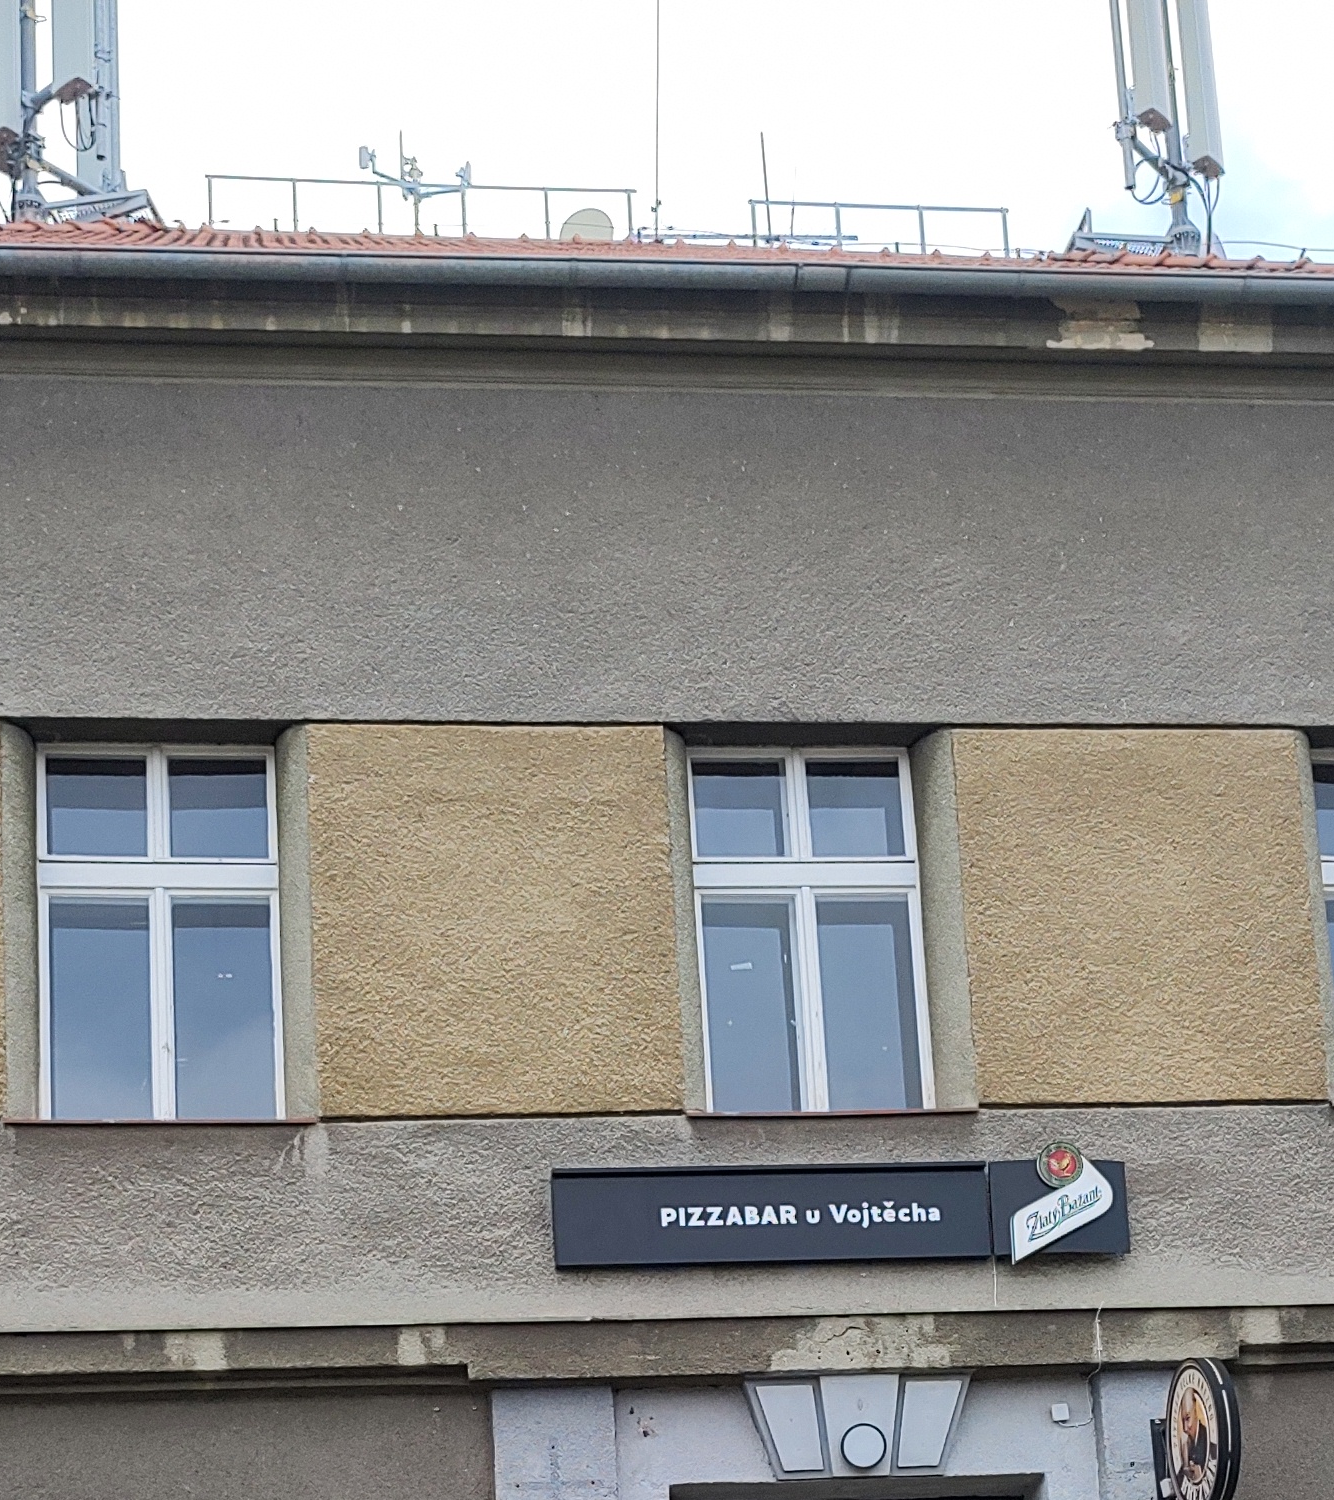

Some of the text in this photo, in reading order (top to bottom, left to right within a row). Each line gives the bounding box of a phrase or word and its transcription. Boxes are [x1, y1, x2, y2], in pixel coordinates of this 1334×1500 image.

[660, 1200, 941, 1228] PIZZABAR u Vojtěcha
